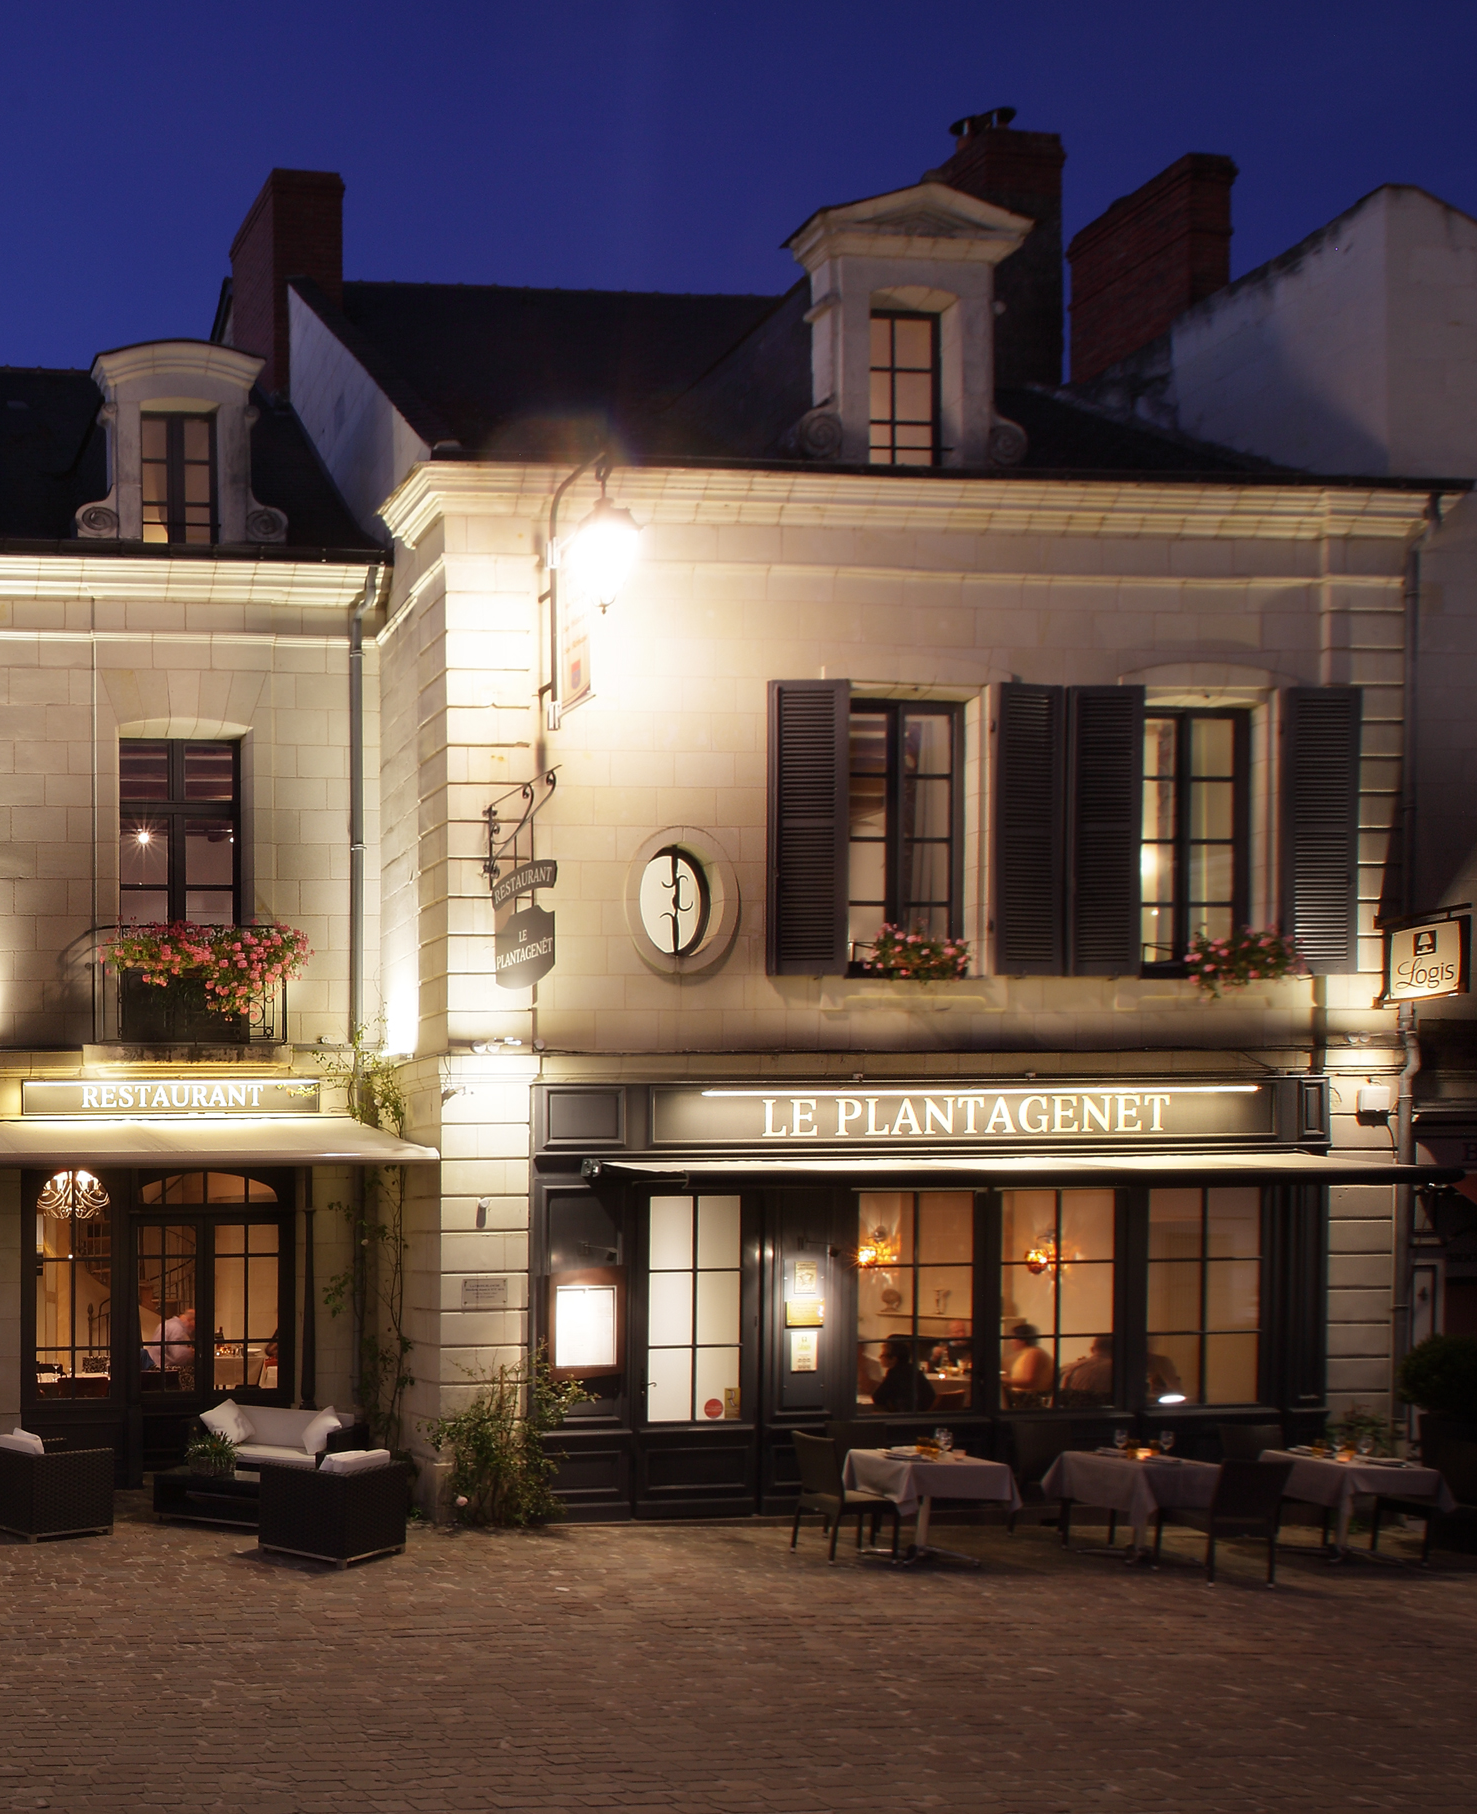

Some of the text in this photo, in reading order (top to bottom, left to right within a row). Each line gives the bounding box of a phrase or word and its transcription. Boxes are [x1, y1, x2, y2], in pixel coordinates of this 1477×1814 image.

[494, 866, 553, 905] RESTAURANT
[518, 929, 528, 943] LE
[1395, 957, 1455, 989] Logis
[81, 1084, 264, 1109] RESTAURANT
[761, 1098, 818, 1138] LE
